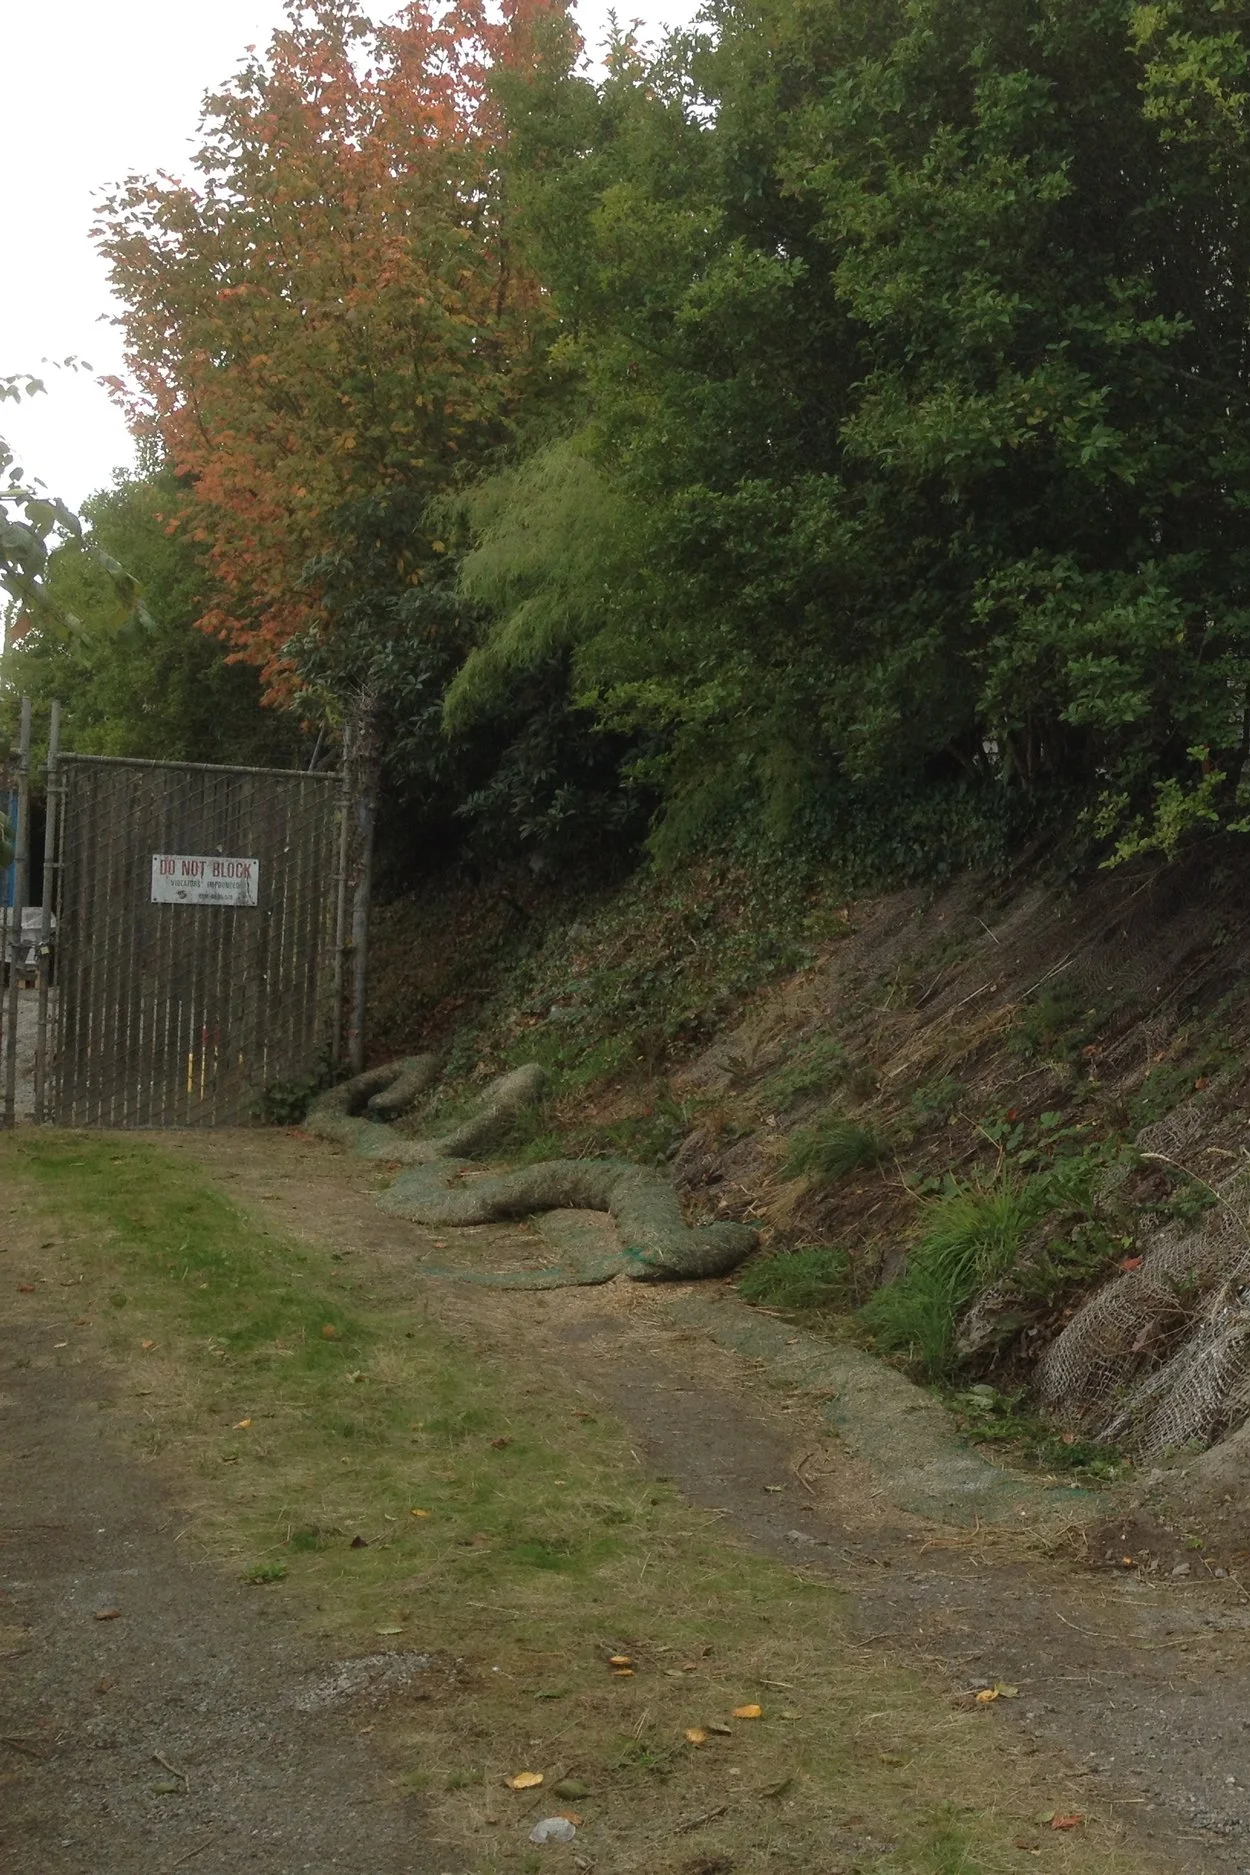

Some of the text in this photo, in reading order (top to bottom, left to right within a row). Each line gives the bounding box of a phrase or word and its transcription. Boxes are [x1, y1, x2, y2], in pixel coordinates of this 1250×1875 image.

[159, 859, 252, 879] DO NOT BLOCK
